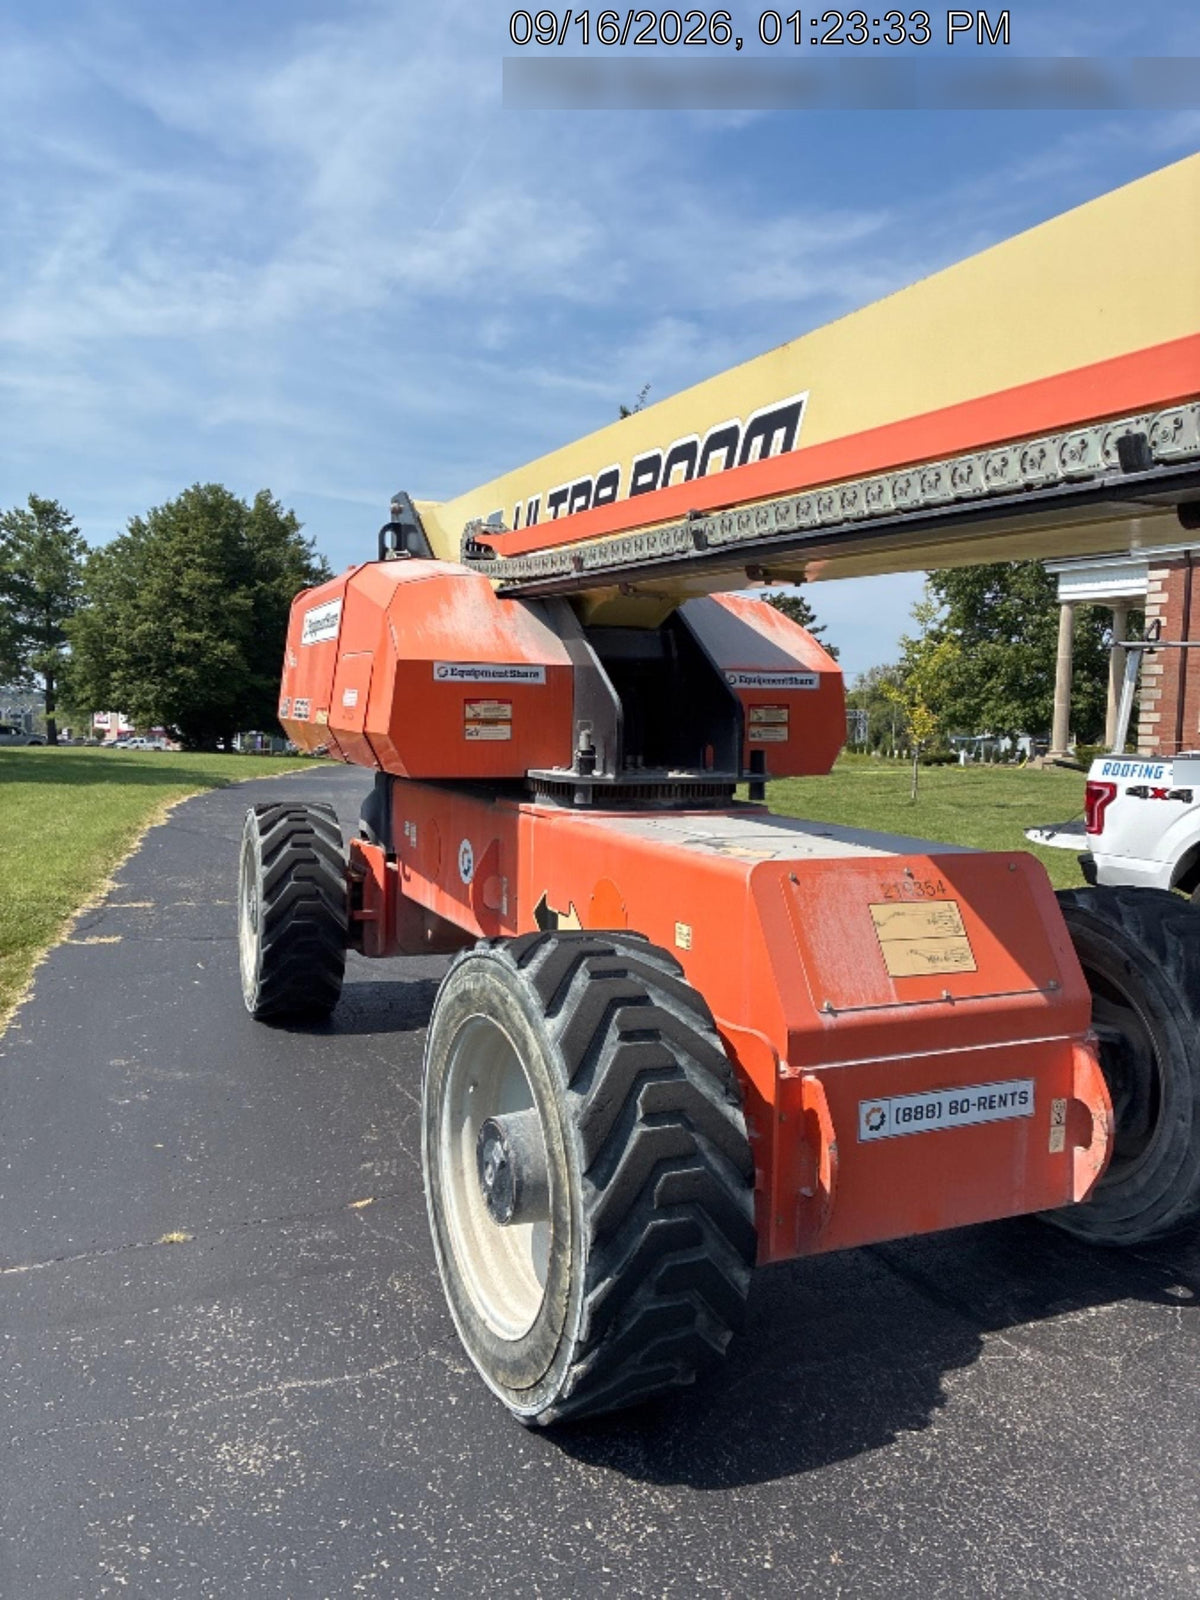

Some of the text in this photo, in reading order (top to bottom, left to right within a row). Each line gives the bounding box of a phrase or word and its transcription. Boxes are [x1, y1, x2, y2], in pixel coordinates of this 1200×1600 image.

[450, 667, 540, 680] EquipmentShare
[1102, 762, 1165, 780] ROOFING
[895, 1090, 1029, 1125] (888) 80-RENTS
